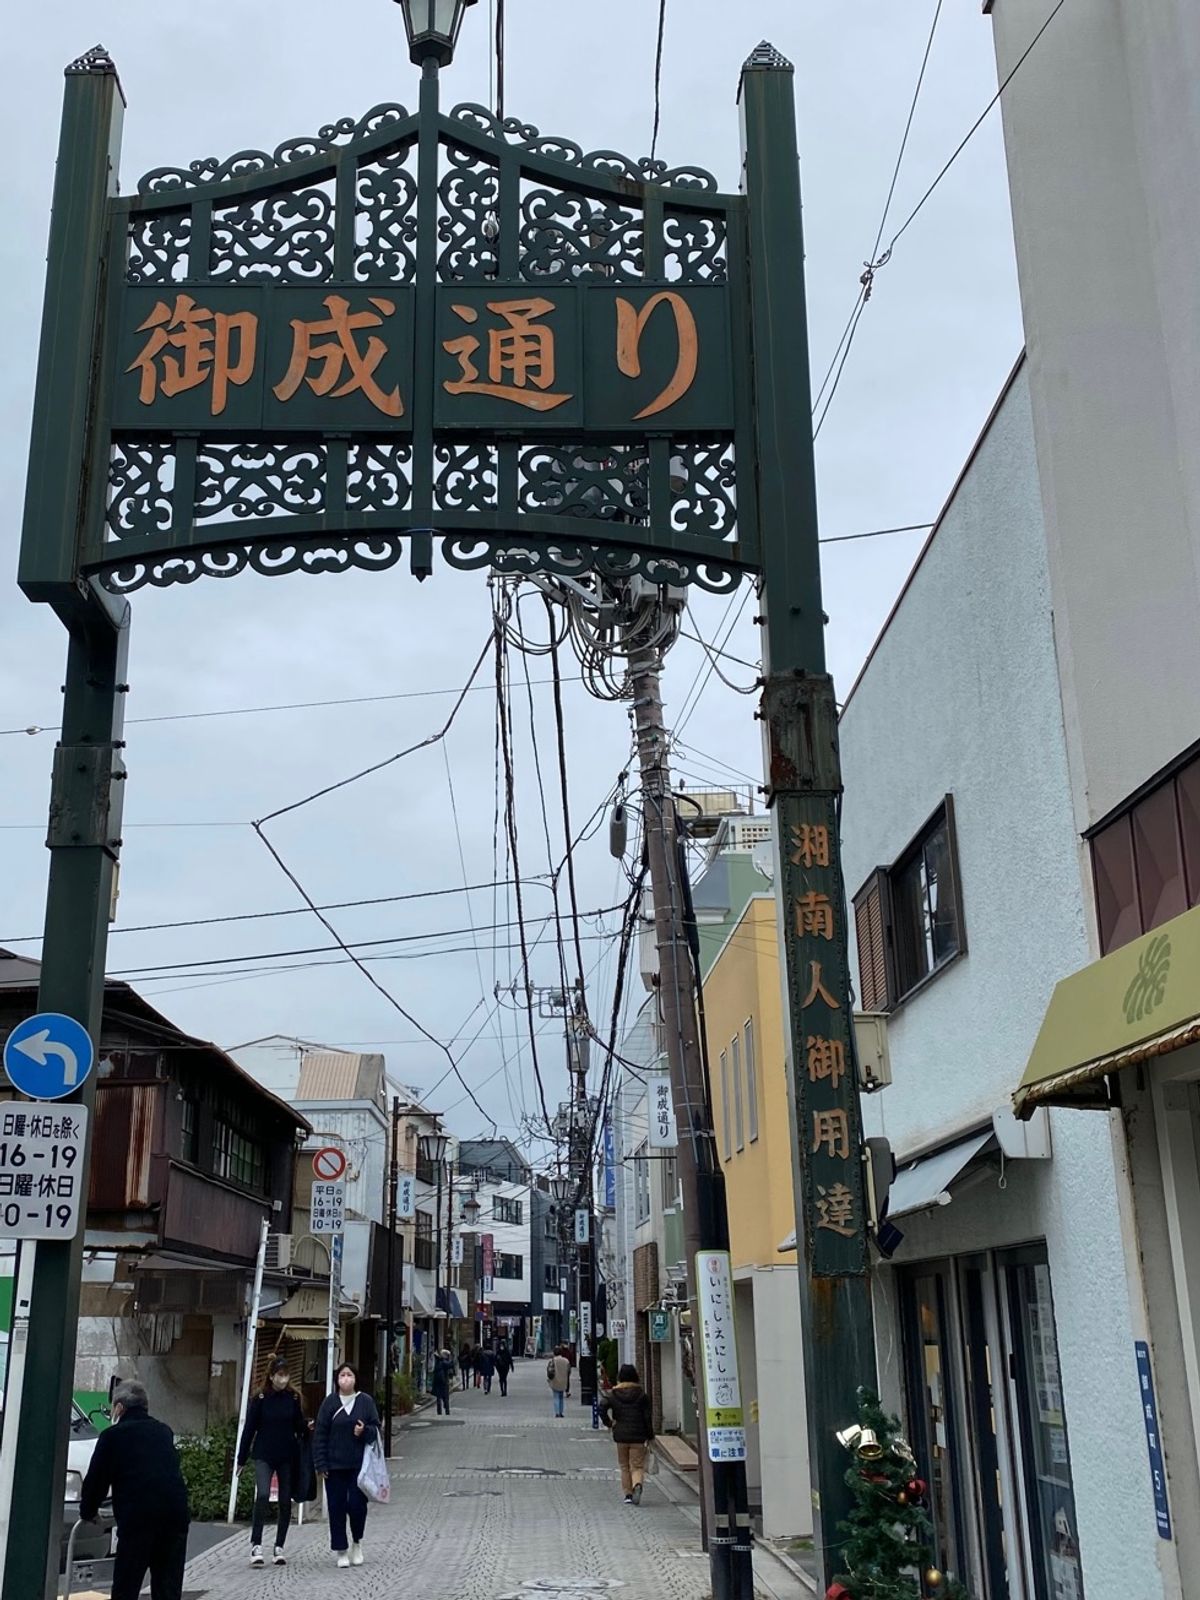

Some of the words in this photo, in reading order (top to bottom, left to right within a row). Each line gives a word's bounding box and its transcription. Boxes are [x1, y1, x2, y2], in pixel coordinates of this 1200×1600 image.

[125, 291, 698, 420] 御成通り
[789, 822, 860, 1239] 湘南人御用達
[656, 1085, 671, 1138] 御成通り
[0, 1203, 71, 1228] 0-19
[312, 1219, 342, 1229] 10-19
[709, 1276, 726, 1373] いにしえにし
